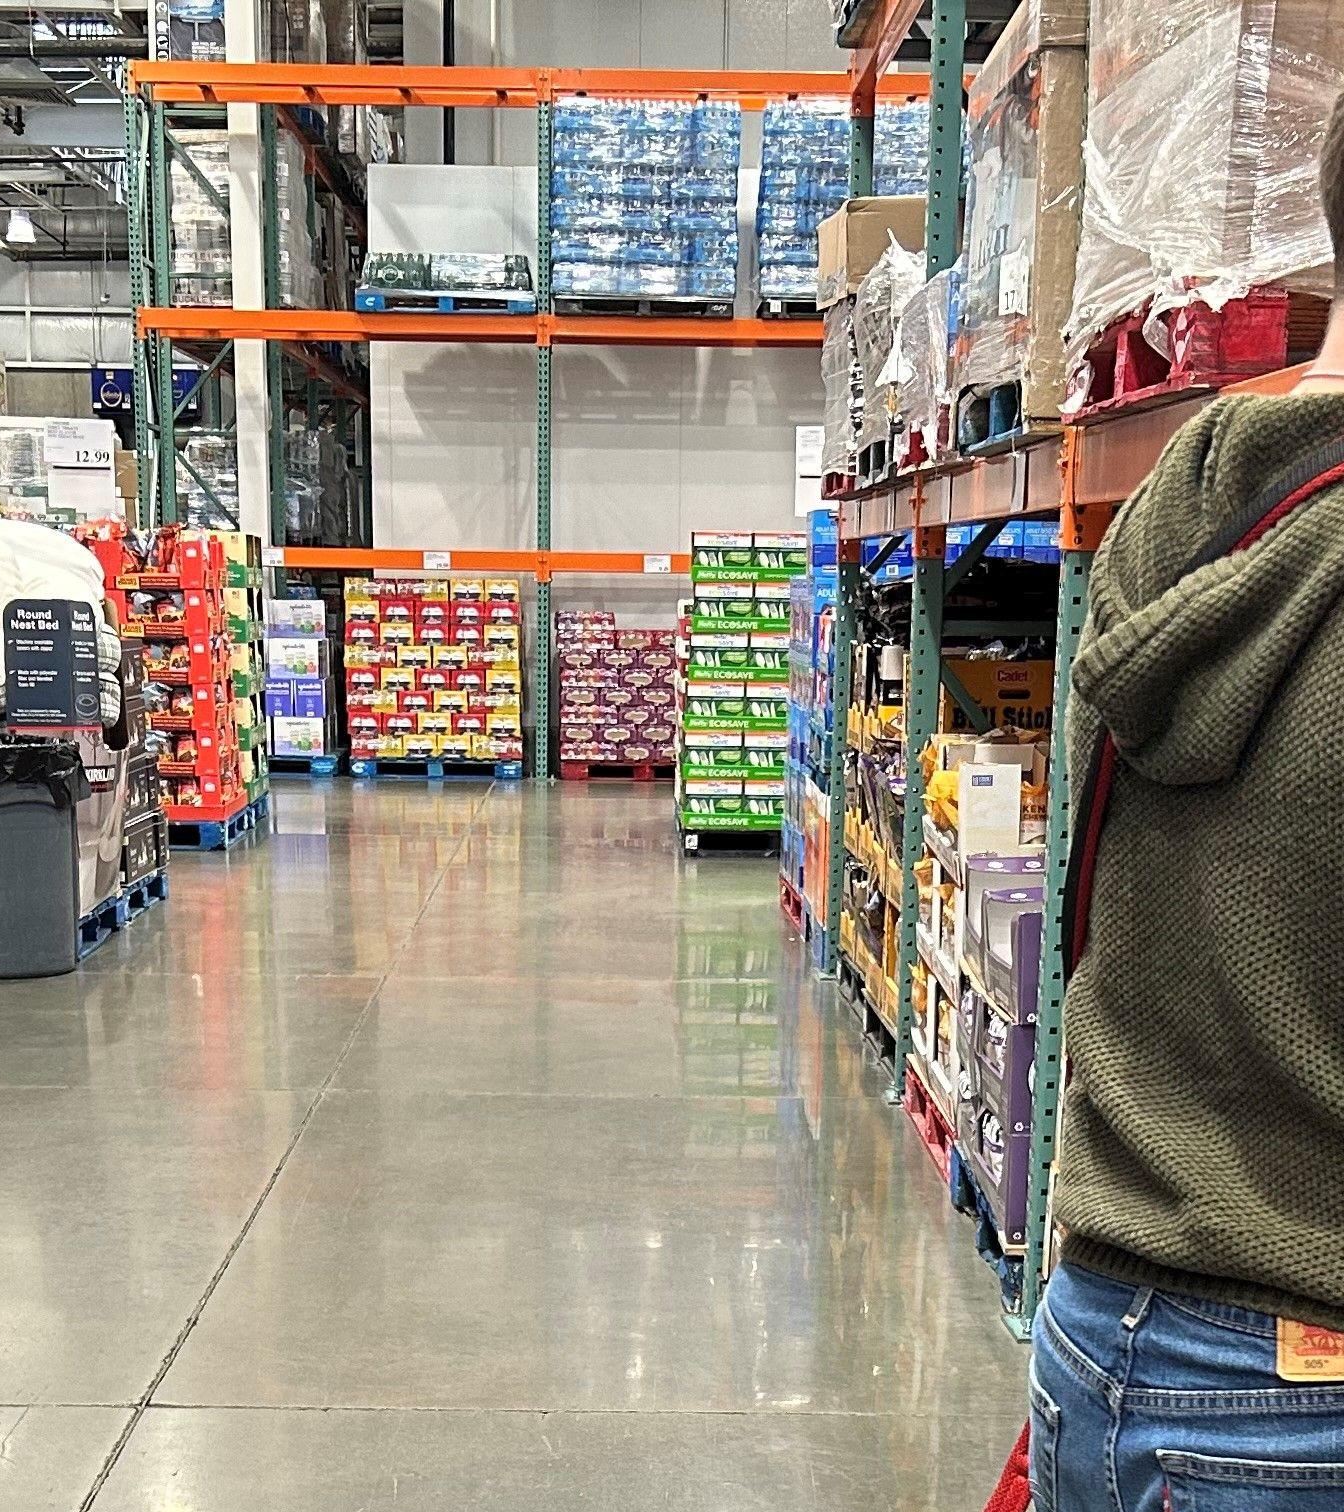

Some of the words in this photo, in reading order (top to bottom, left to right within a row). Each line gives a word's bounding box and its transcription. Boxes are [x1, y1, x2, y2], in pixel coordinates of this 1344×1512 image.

[76, 451, 109, 463] 12.99
[717, 571, 759, 580] ECOSAVE
[17, 609, 51, 620] Round
[11, 620, 36, 630] Nest
[38, 620, 59, 630] Bed
[717, 621, 758, 629] ECOSAVE
[714, 671, 754, 679] ECOSAVE
[709, 769, 748, 777] ECOSAVE
